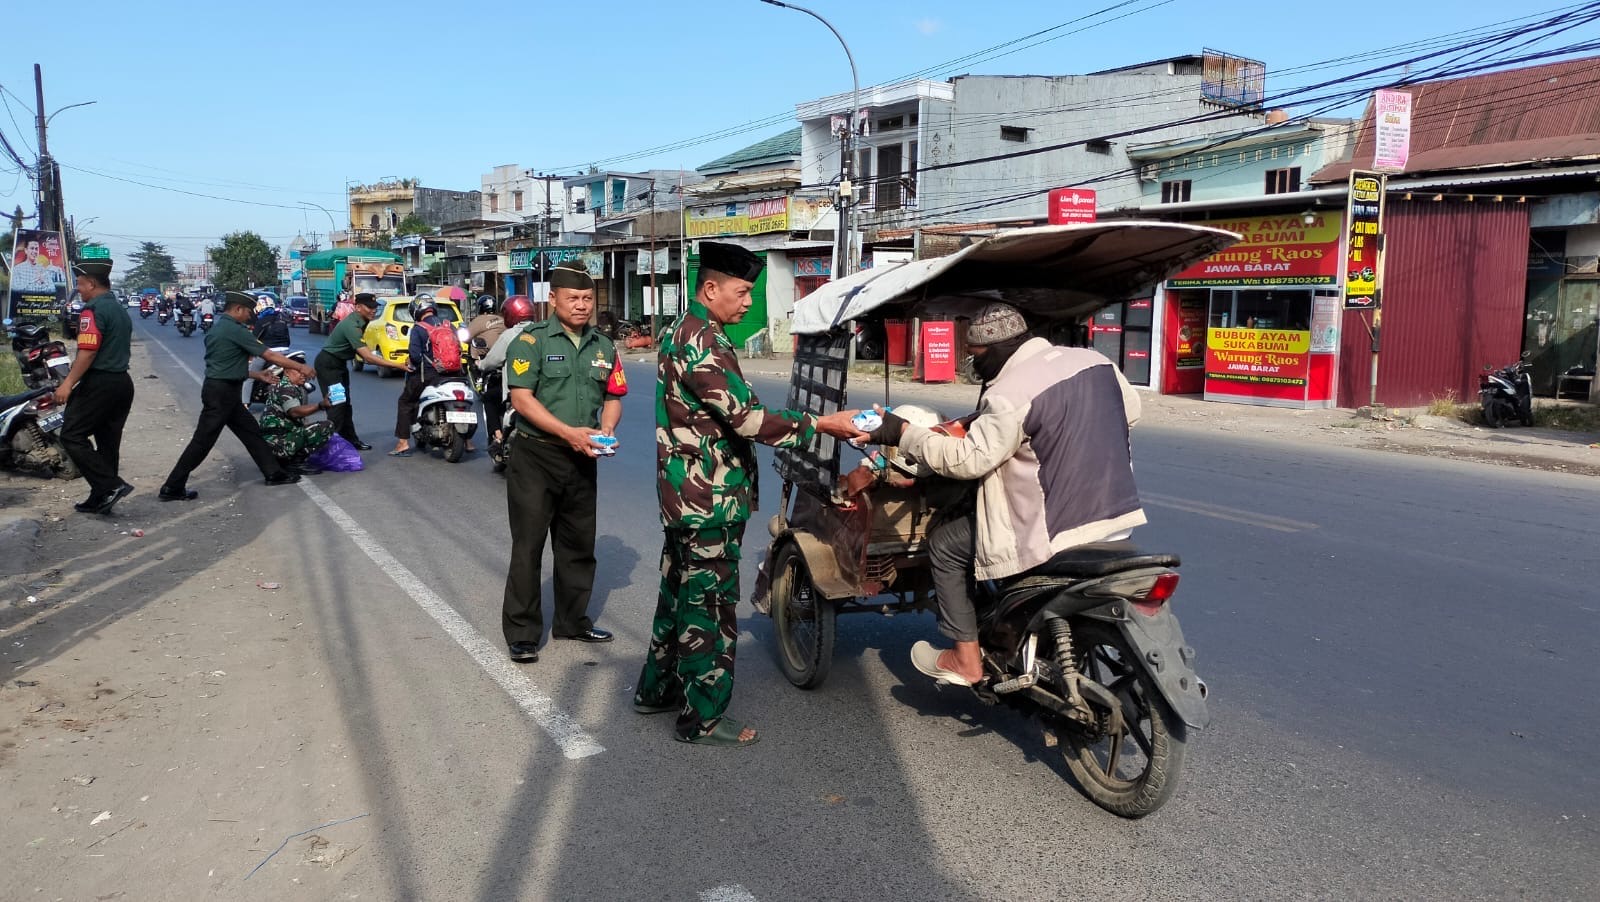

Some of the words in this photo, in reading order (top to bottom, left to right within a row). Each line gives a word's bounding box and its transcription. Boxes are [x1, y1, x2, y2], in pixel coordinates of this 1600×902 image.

[689, 218, 744, 236] MODERN
[1258, 216, 1325, 231] AYAM
[1355, 237, 1364, 248] LAS
[1266, 247, 1324, 262] Raos
[1204, 263, 1241, 273] JAWA
[1244, 262, 1292, 272] BARAT
[1173, 279, 1201, 287] TERIMA
[1262, 276, 1331, 286] 08875102473
[1214, 330, 1256, 341] BUBUR
[1260, 332, 1301, 343] AYAM
[1223, 340, 1289, 351] SUKABUMI
[1213, 351, 1263, 367] Warung
[1264, 353, 1300, 366] Raos
[1227, 363, 1250, 371] JAWA
[1250, 364, 1280, 373] BARAT
